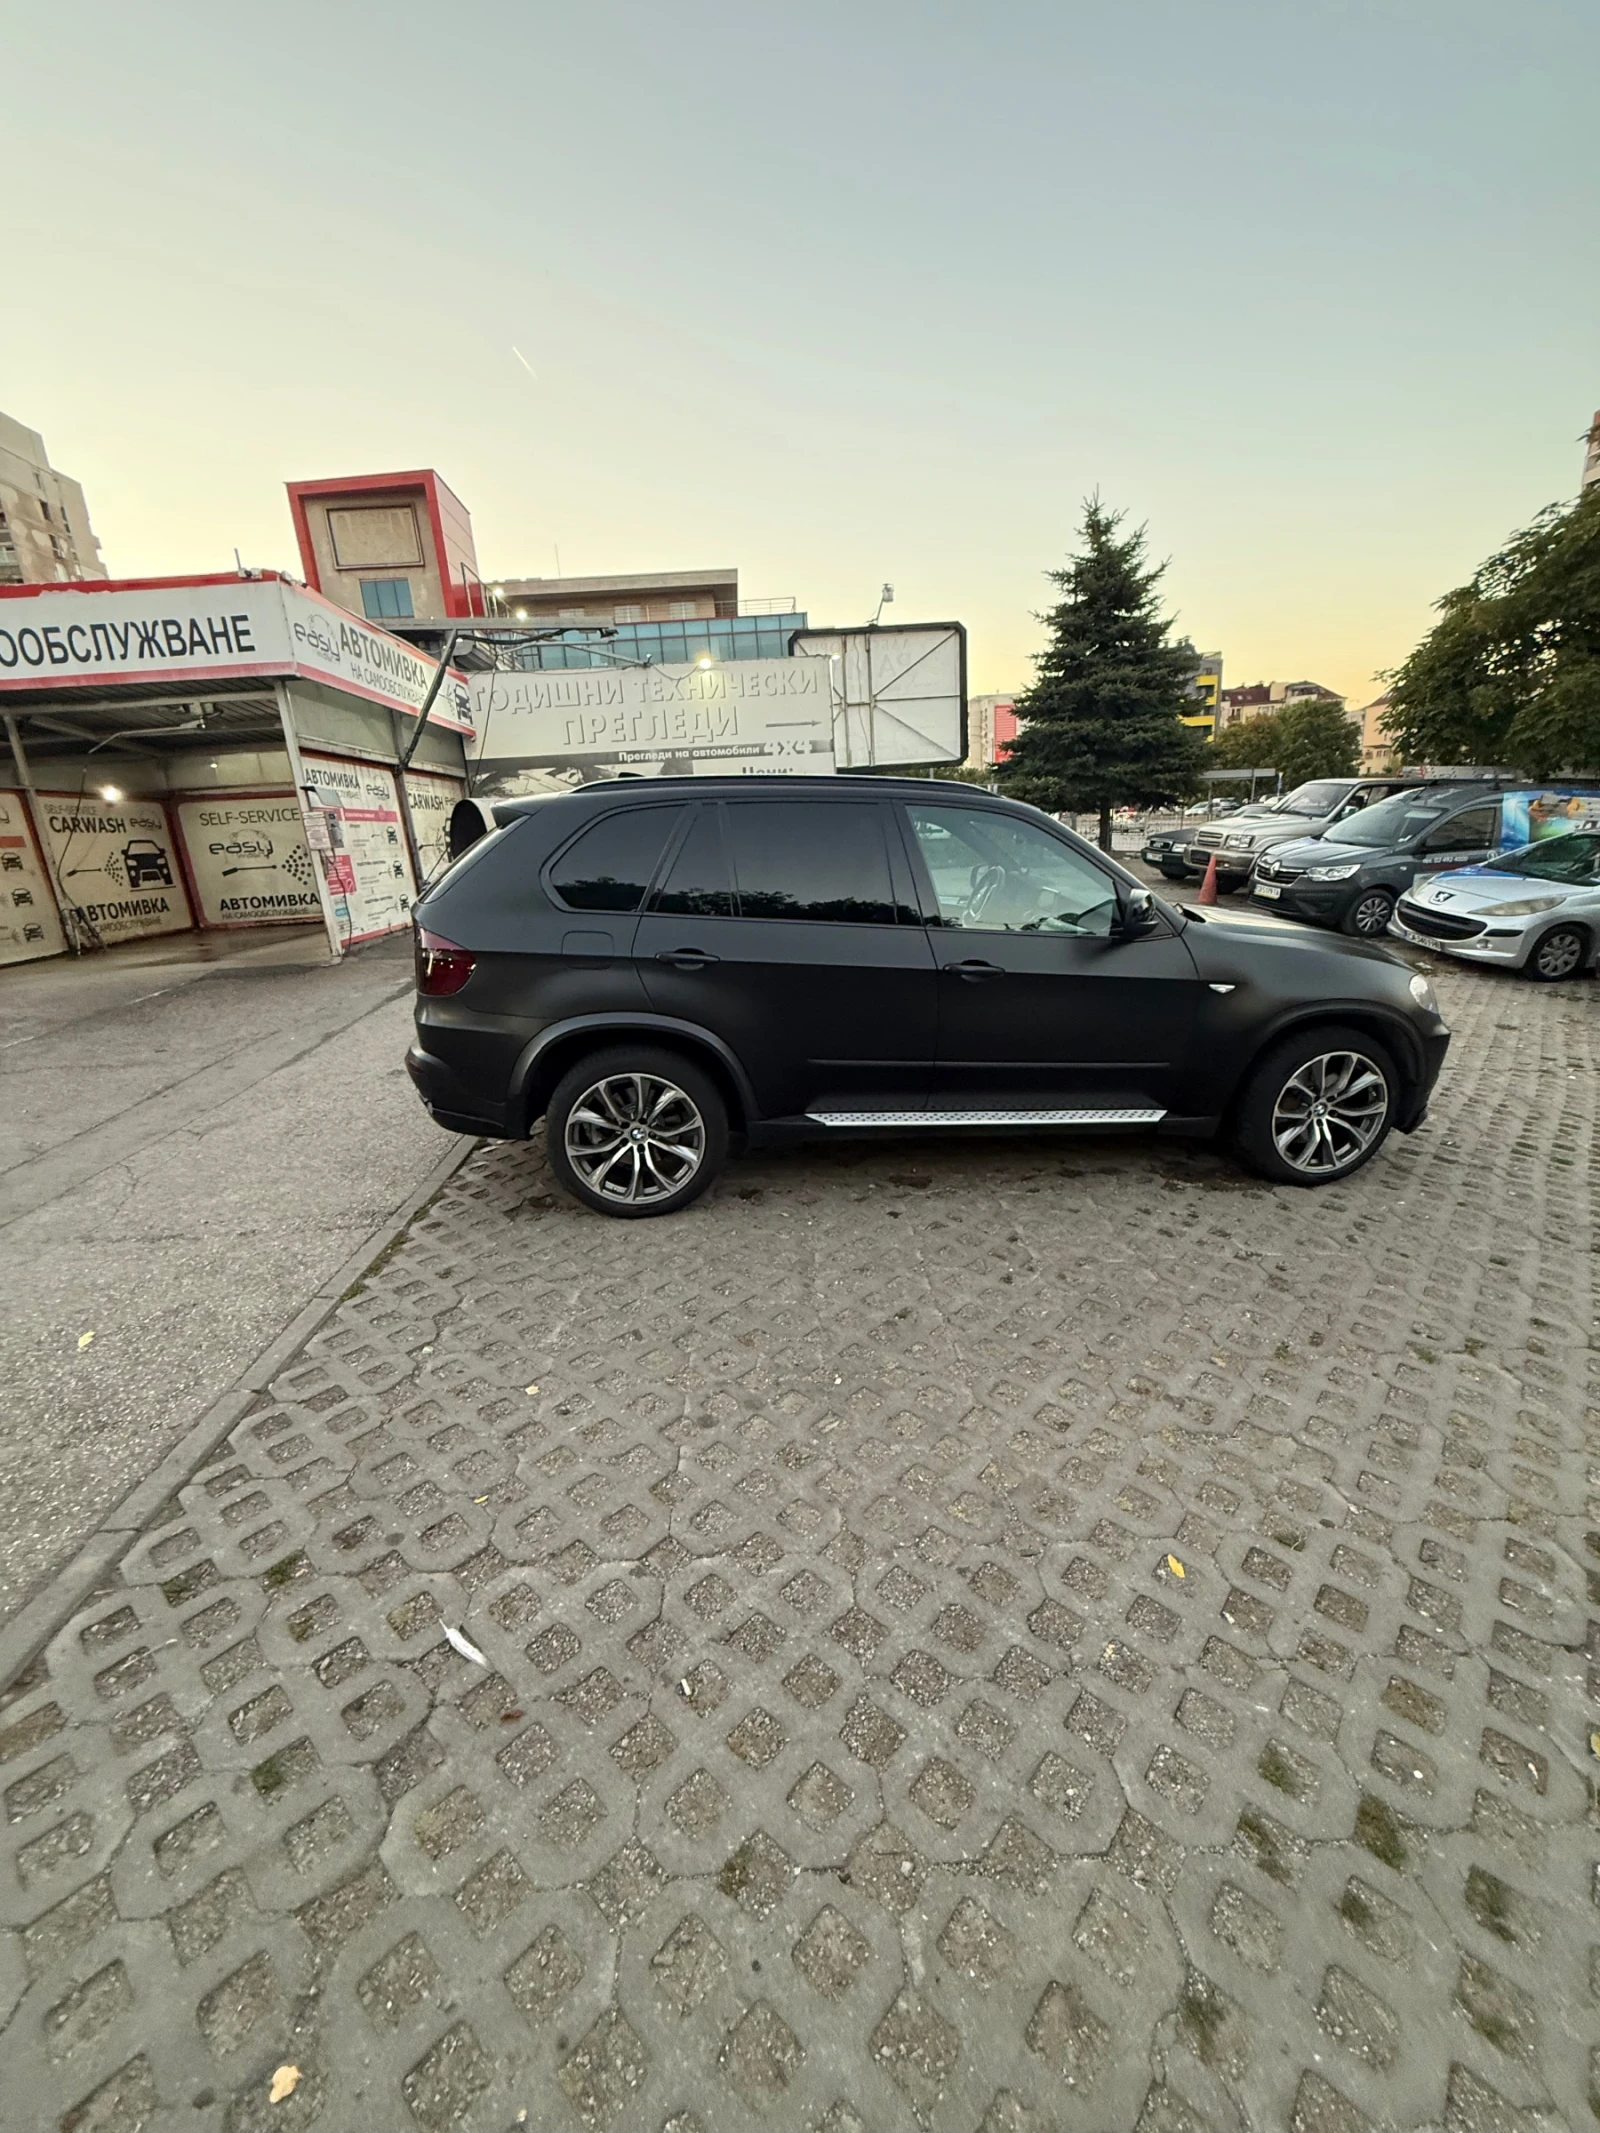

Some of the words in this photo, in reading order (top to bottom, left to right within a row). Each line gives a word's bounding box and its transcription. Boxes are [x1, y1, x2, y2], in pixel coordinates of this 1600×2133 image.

[340, 622, 428, 691] АВТОМИВКА
[351, 664, 363, 681] НА
[474, 677, 624, 715] ГОДИШНИ
[635, 669, 818, 703] ТЕХНИЧЕСКИ
[563, 705, 739, 745] ПРЕГЛЕДИ
[618, 751, 673, 762] Прегледи
[675, 750, 689, 759] на
[692, 746, 760, 758] автомобили
[305, 768, 360, 789] АВТОМИВКА
[49, 816, 127, 833] CARWASH
[199, 807, 301, 826] SELF-SERVICE
[209, 840, 274, 859] easy
[220, 892, 320, 911] АВТОМИВКА
